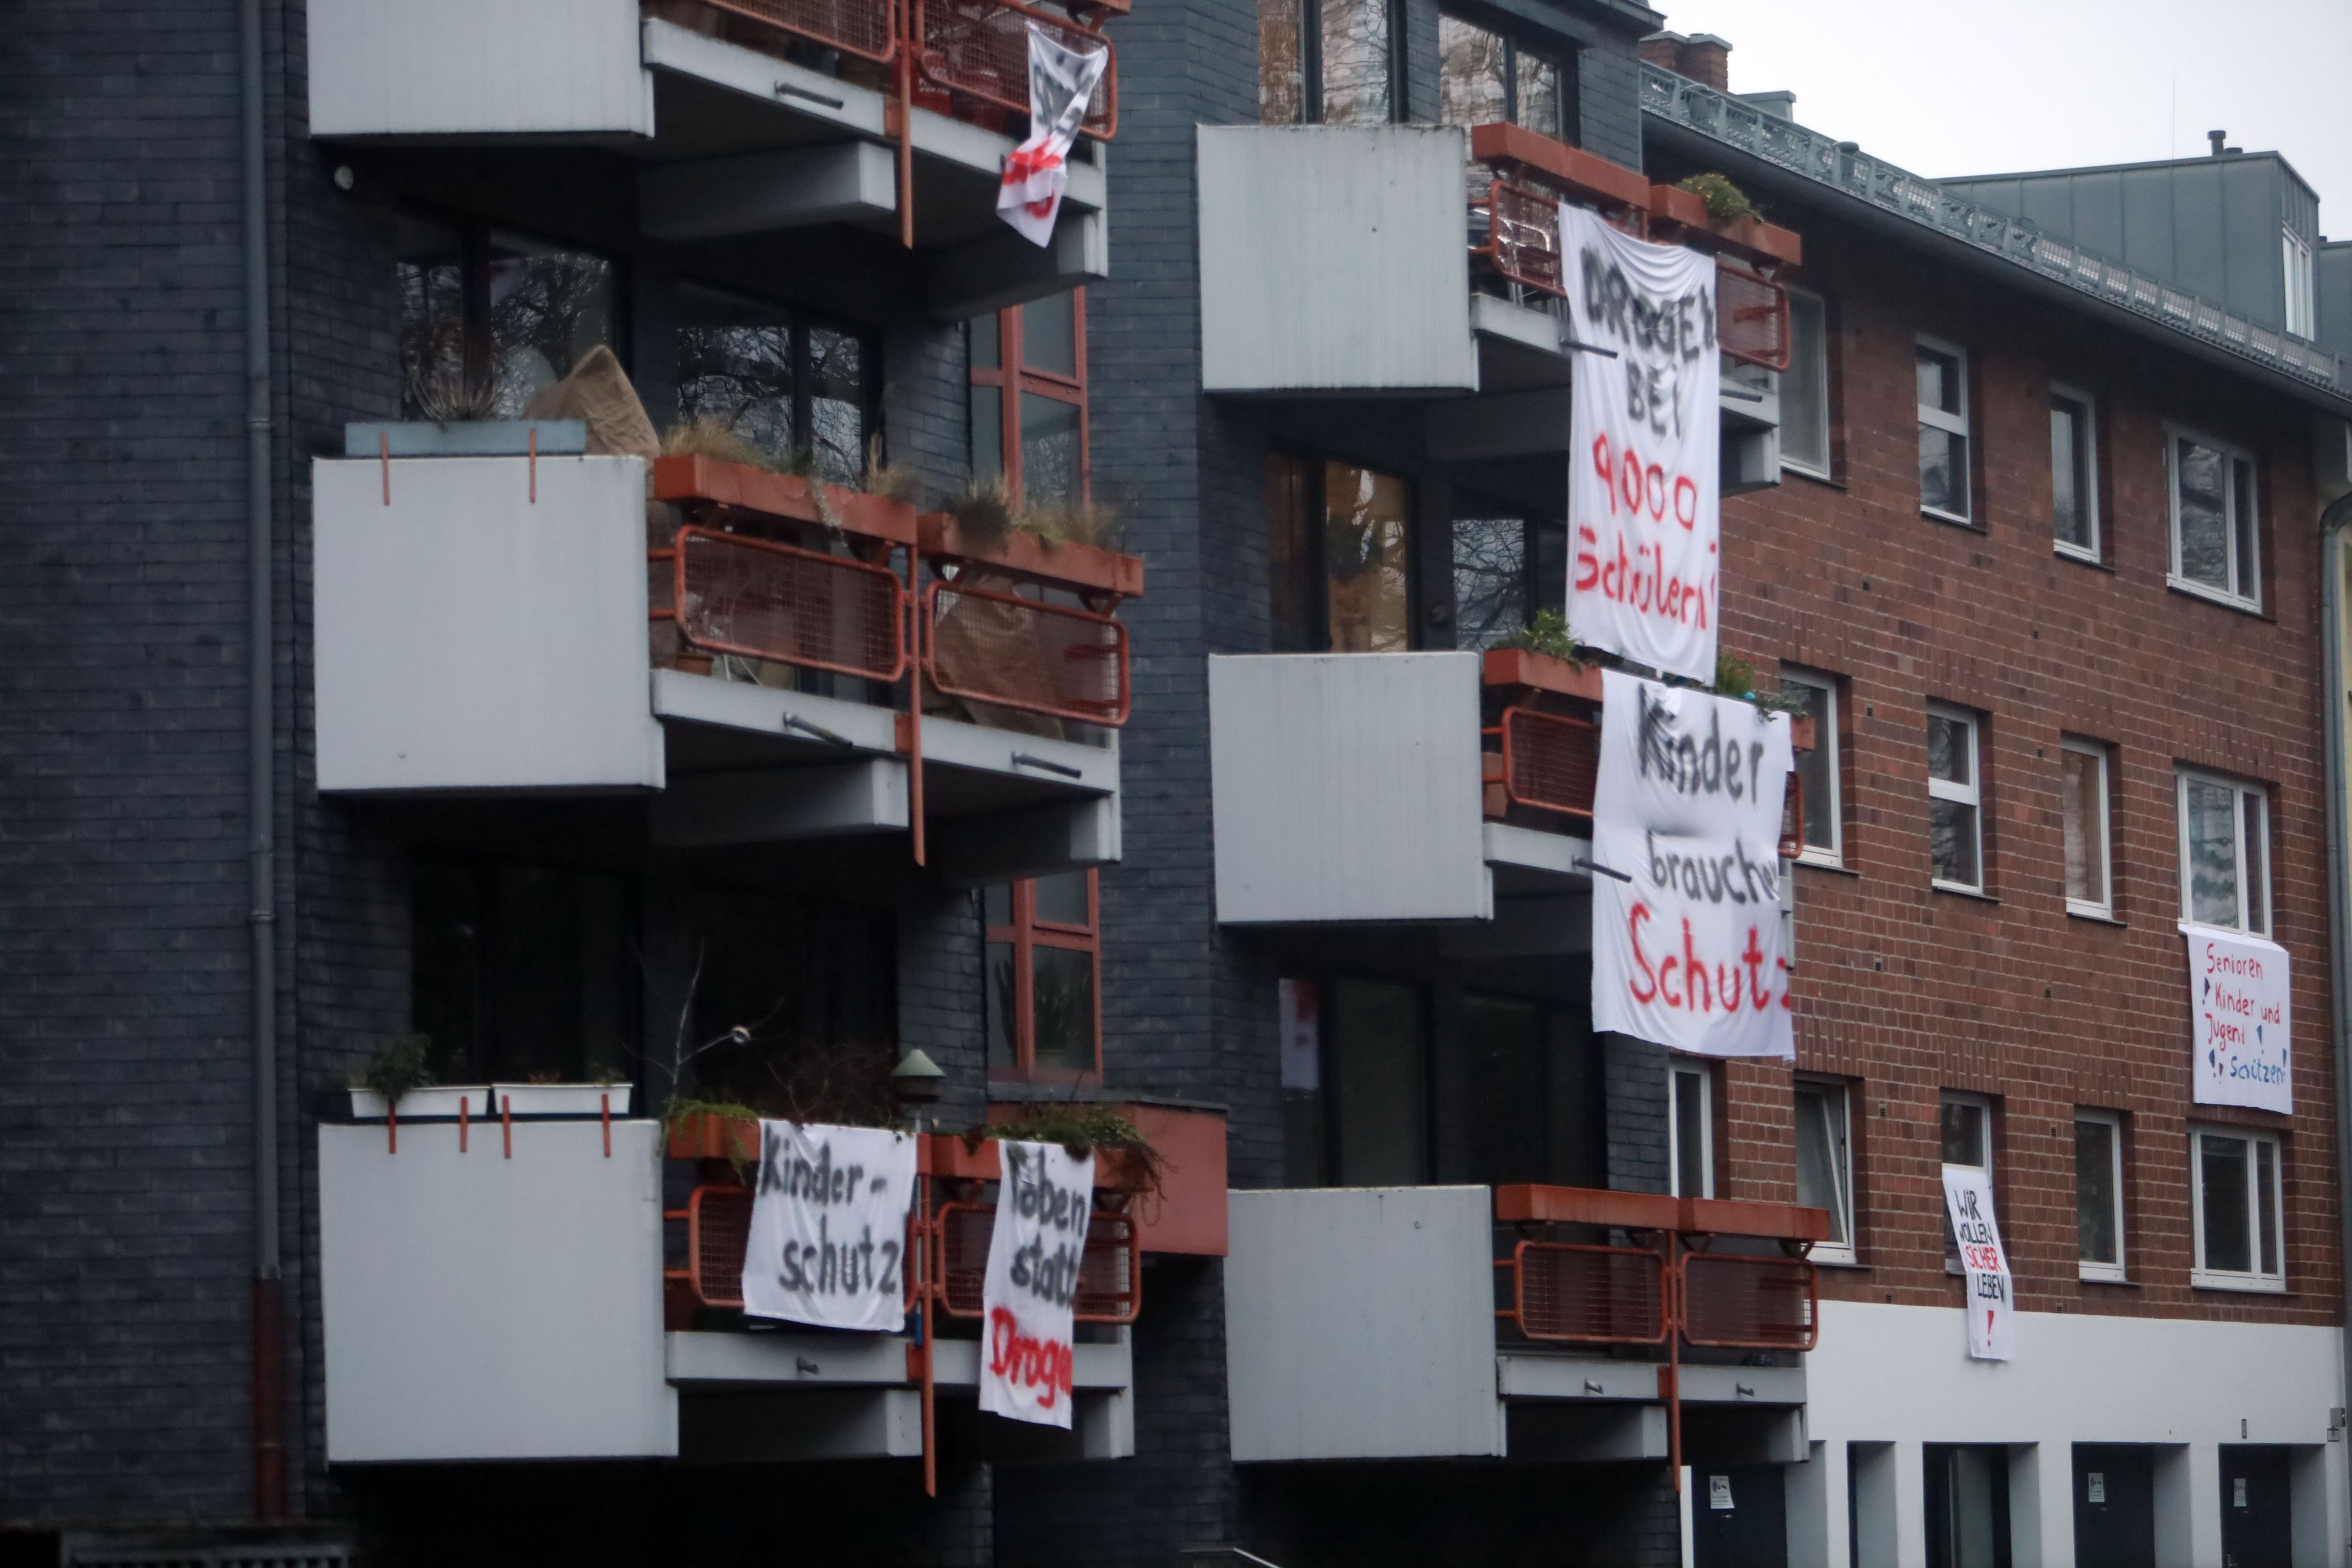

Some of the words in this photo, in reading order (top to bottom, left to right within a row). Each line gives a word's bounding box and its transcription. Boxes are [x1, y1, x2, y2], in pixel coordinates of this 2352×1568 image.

[1581, 246, 1715, 363] DROGEN
[1626, 360, 1681, 440] BEI
[1593, 434, 1697, 532] 9000
[1638, 682, 1764, 805] Kinder
[2206, 942, 2263, 981] Senioren
[2214, 982, 2255, 1017] Kinder
[2260, 1001, 2280, 1025] und
[1959, 1222, 1994, 1245] WOLLEN
